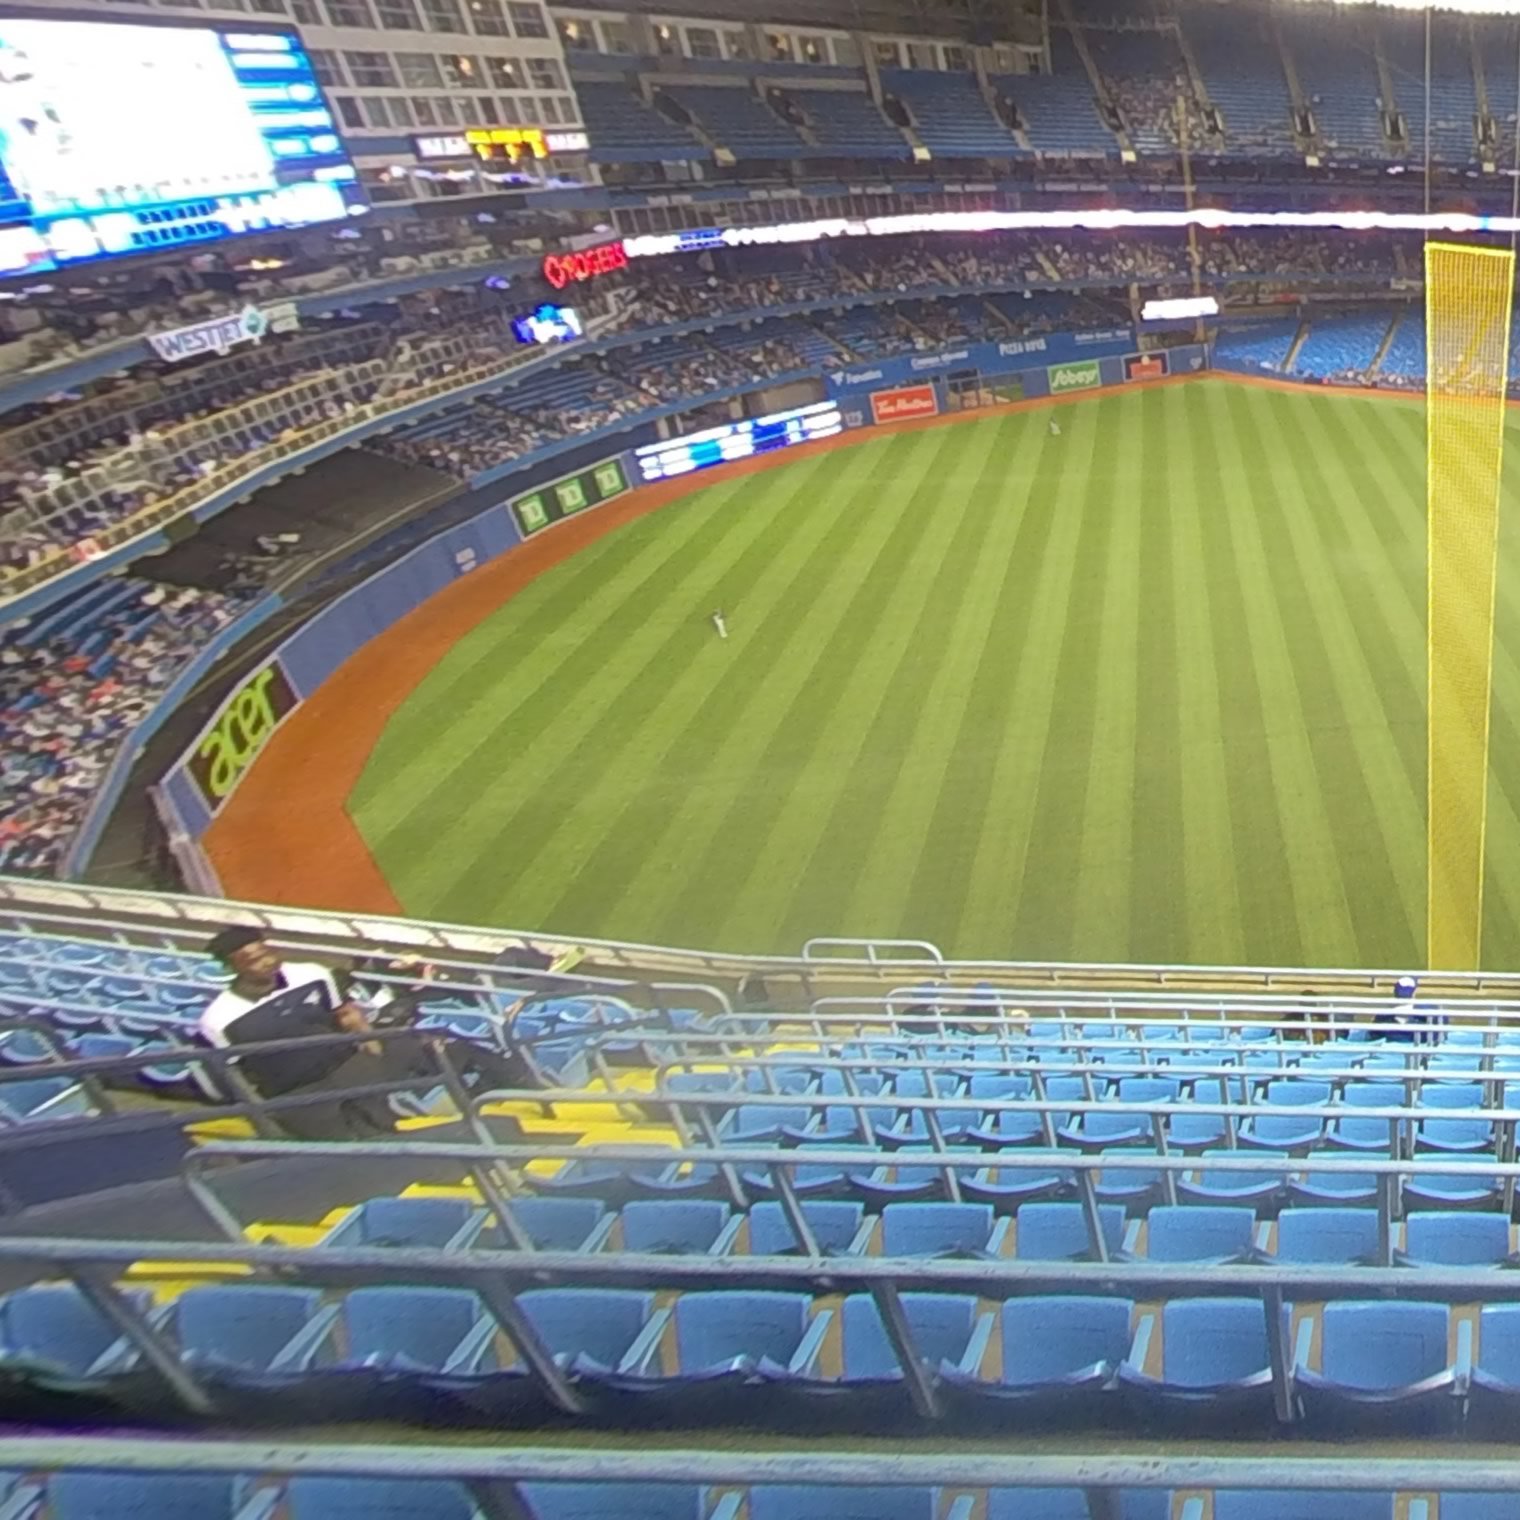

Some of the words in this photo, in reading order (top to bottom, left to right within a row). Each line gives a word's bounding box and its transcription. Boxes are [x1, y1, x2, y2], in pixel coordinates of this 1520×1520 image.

[561, 242, 628, 279] ROGERS
[154, 316, 243, 357] WESTJET
[202, 668, 274, 797] acer
